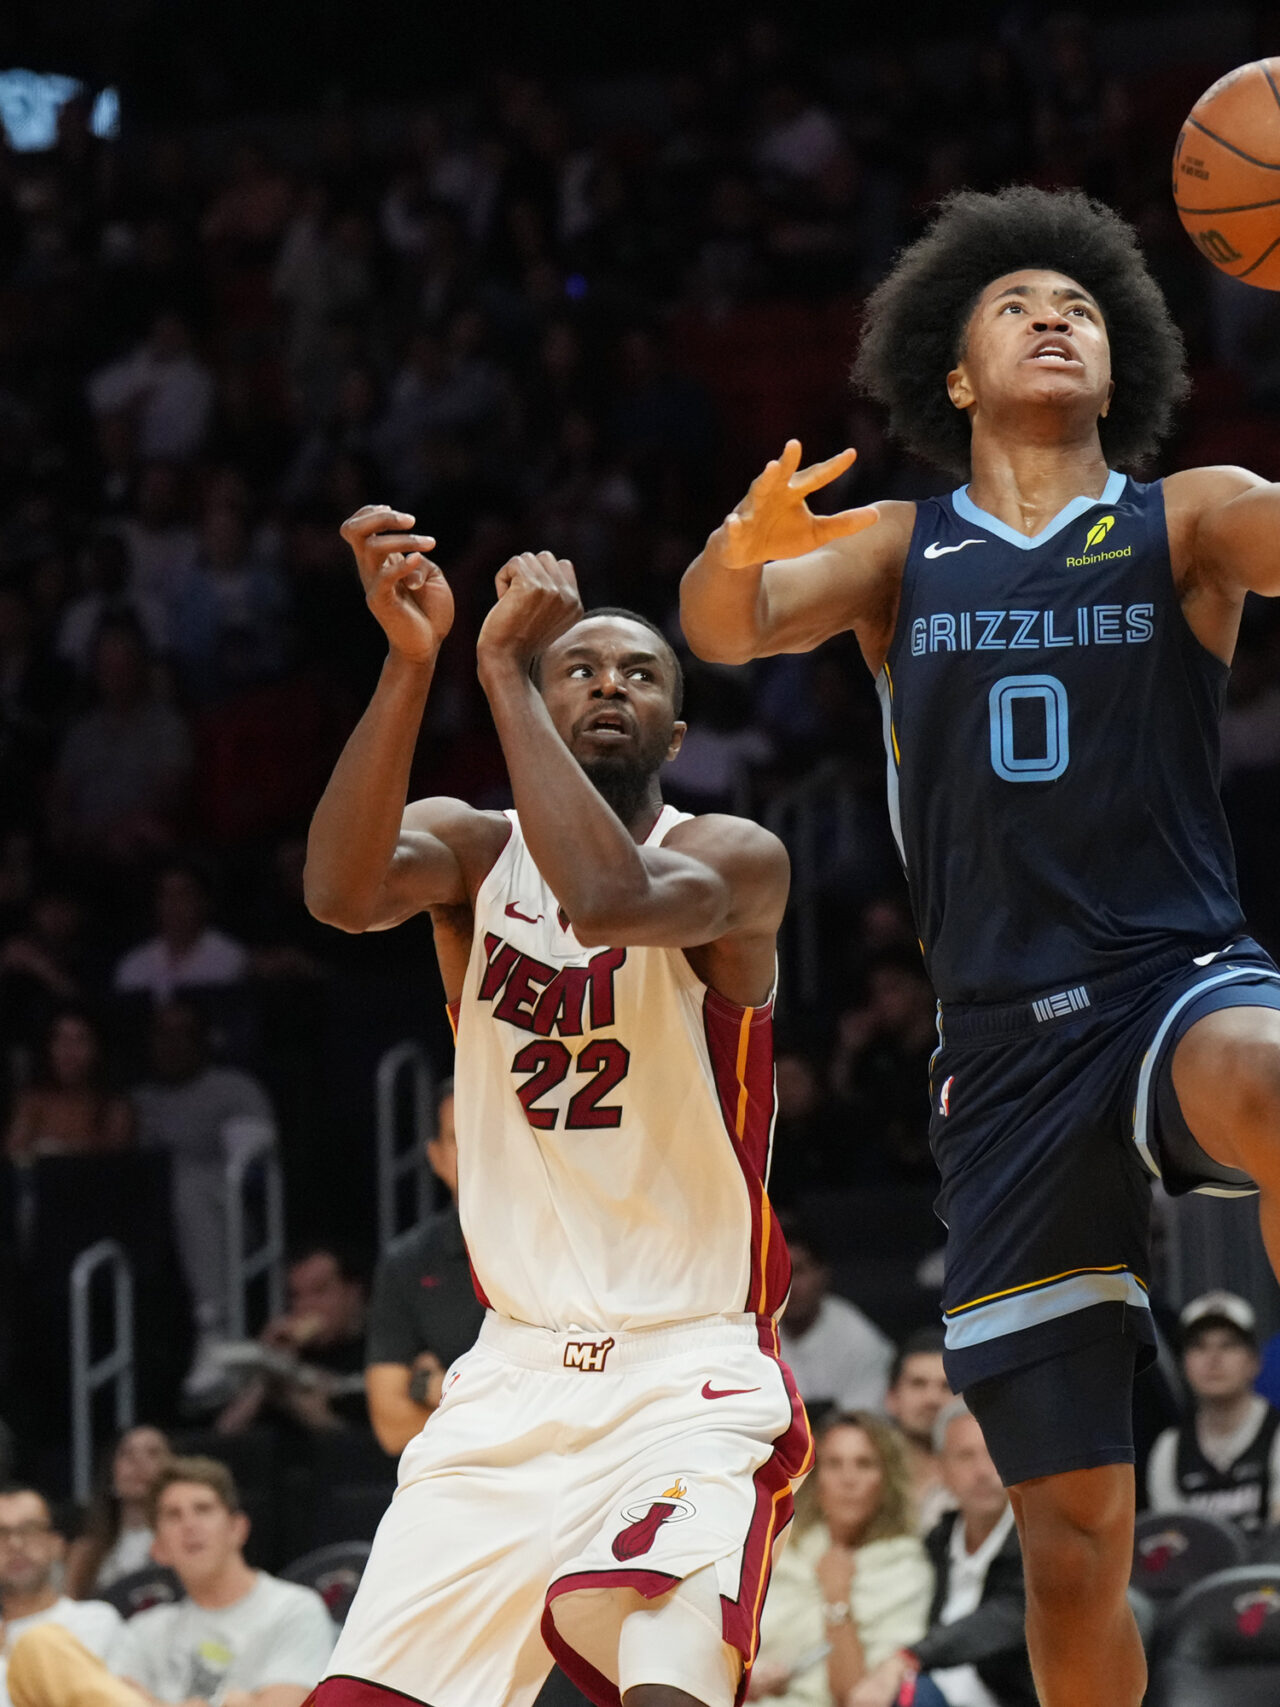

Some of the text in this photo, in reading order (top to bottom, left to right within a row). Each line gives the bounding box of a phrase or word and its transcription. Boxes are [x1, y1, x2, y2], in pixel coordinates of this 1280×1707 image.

[1066, 545, 1132, 568] Robinhood
[911, 603, 1154, 656] GRIZZLIES
[989, 674, 1070, 783] 0
[511, 1039, 630, 1130] 22
